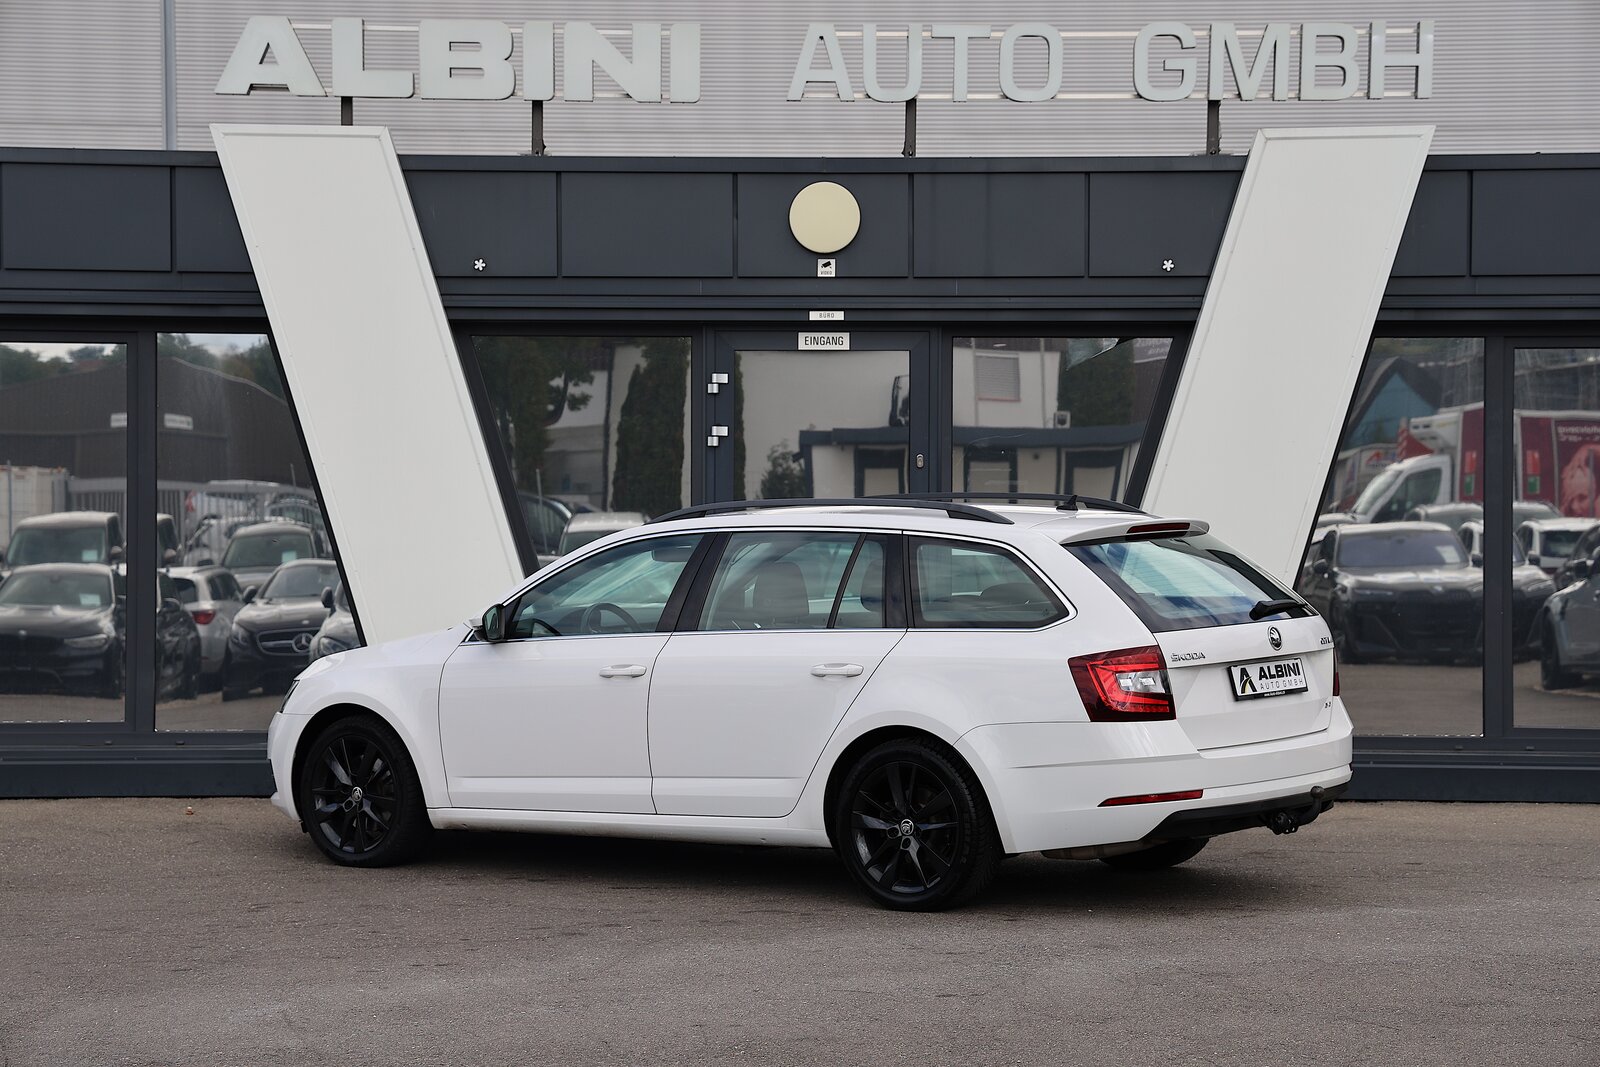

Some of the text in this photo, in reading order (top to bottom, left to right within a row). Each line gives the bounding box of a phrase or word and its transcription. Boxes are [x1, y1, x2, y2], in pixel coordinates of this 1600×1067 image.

[214, 16, 1436, 104] ALBINI AUTO GMBH
[804, 336, 844, 346] EINGANG
[1259, 662, 1301, 681] ALBINI
[1260, 678, 1304, 690] AUTO GMBH
